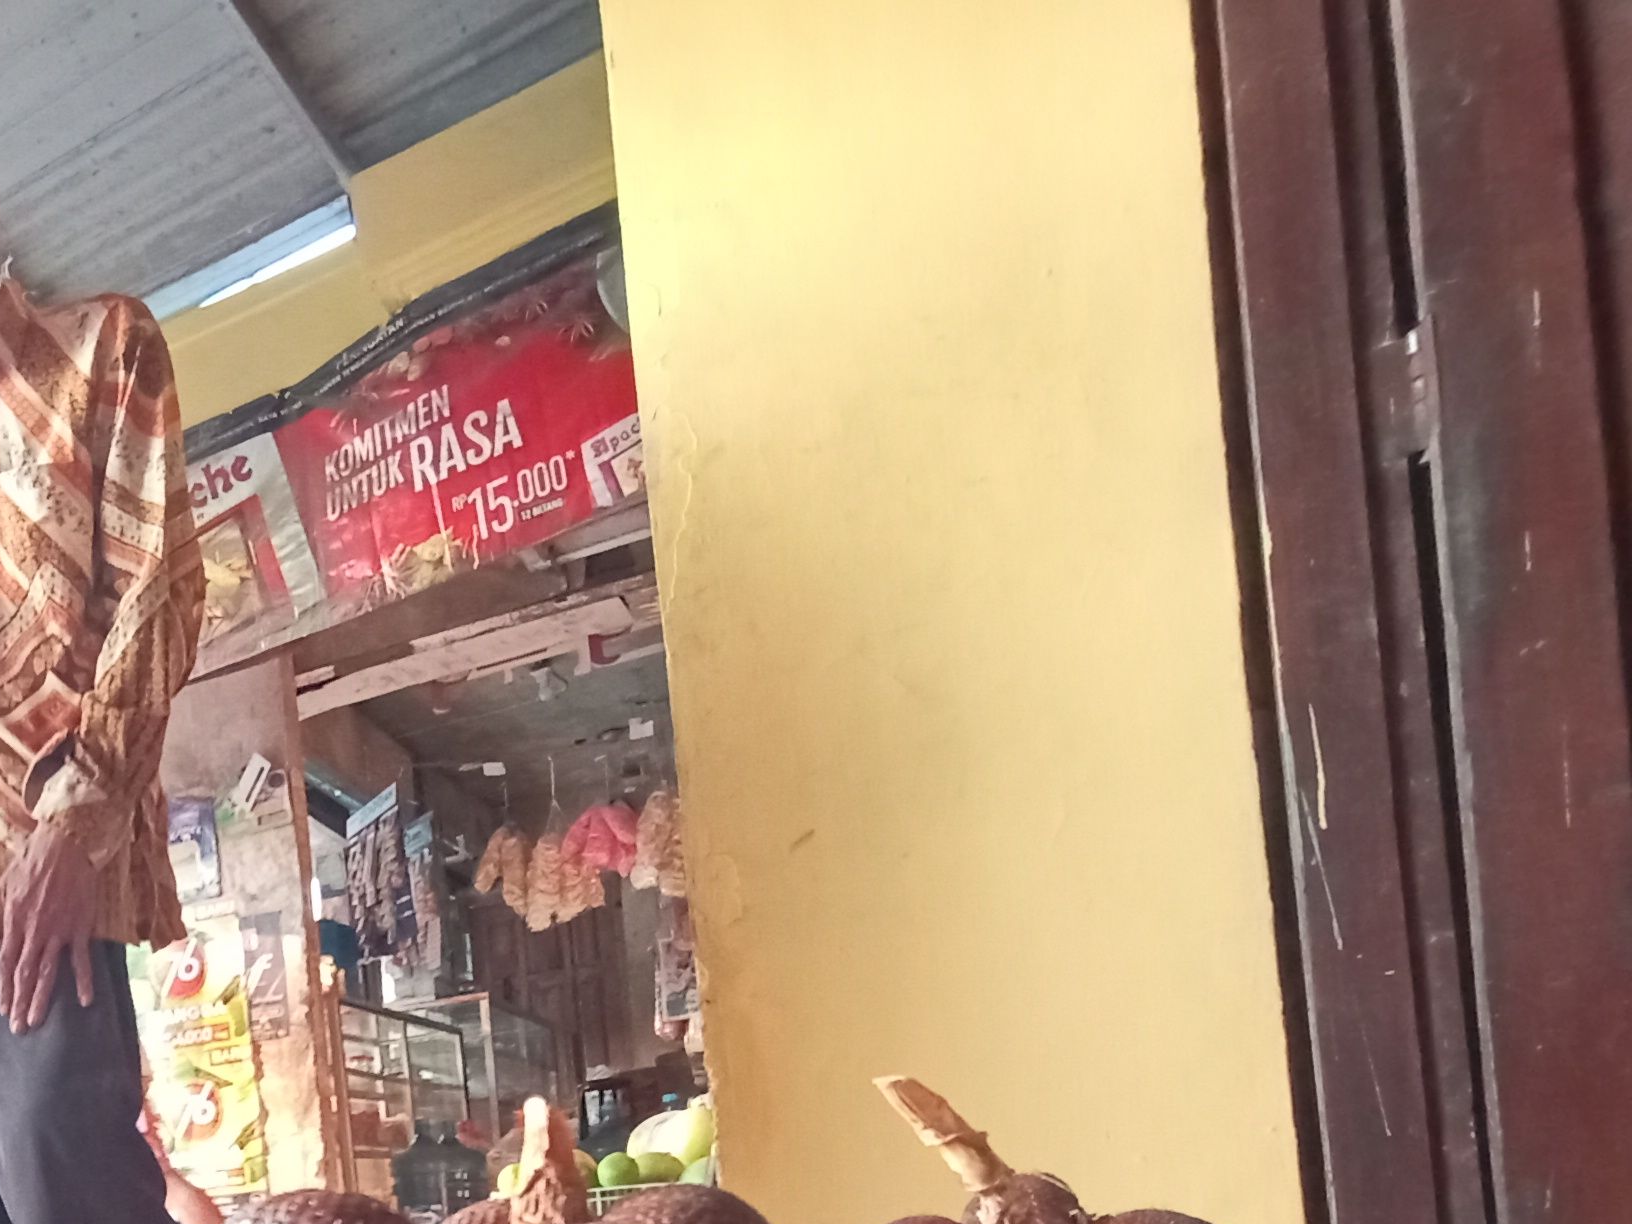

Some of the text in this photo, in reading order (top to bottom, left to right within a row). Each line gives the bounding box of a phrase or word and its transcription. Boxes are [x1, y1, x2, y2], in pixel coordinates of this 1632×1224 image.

[189, 455, 253, 509] che
[325, 384, 451, 482] KOMITMEN
[326, 398, 523, 522] UNTUK RASA
